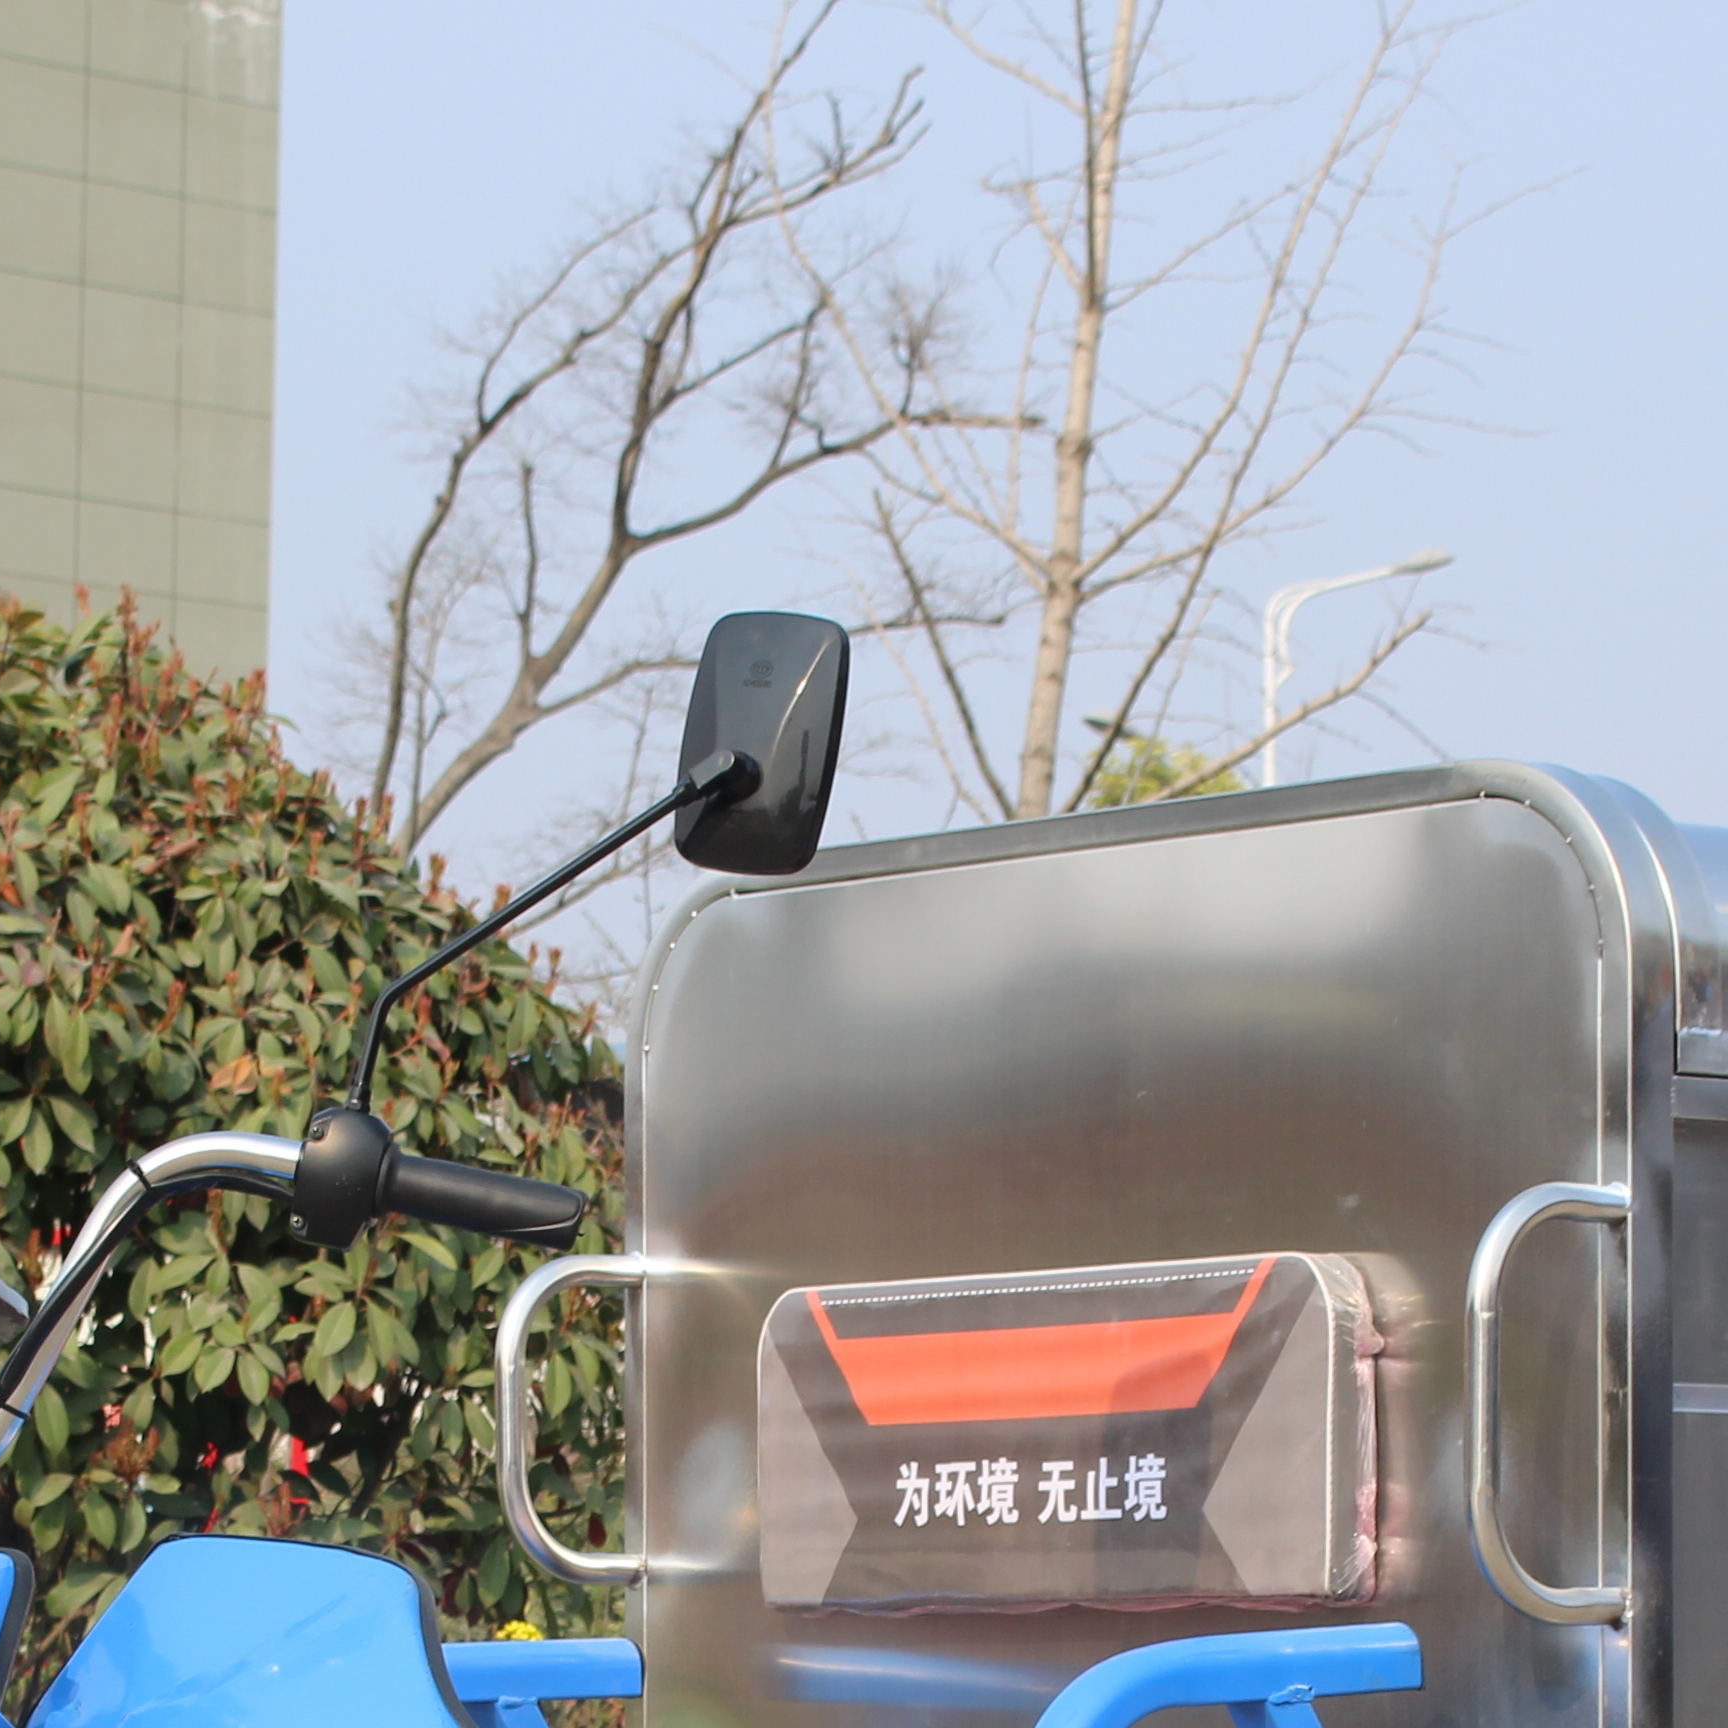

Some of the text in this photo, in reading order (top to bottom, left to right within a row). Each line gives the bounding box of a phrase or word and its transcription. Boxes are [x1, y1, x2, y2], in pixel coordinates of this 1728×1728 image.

[893, 1453, 1168, 1527] 为环境 无止境
